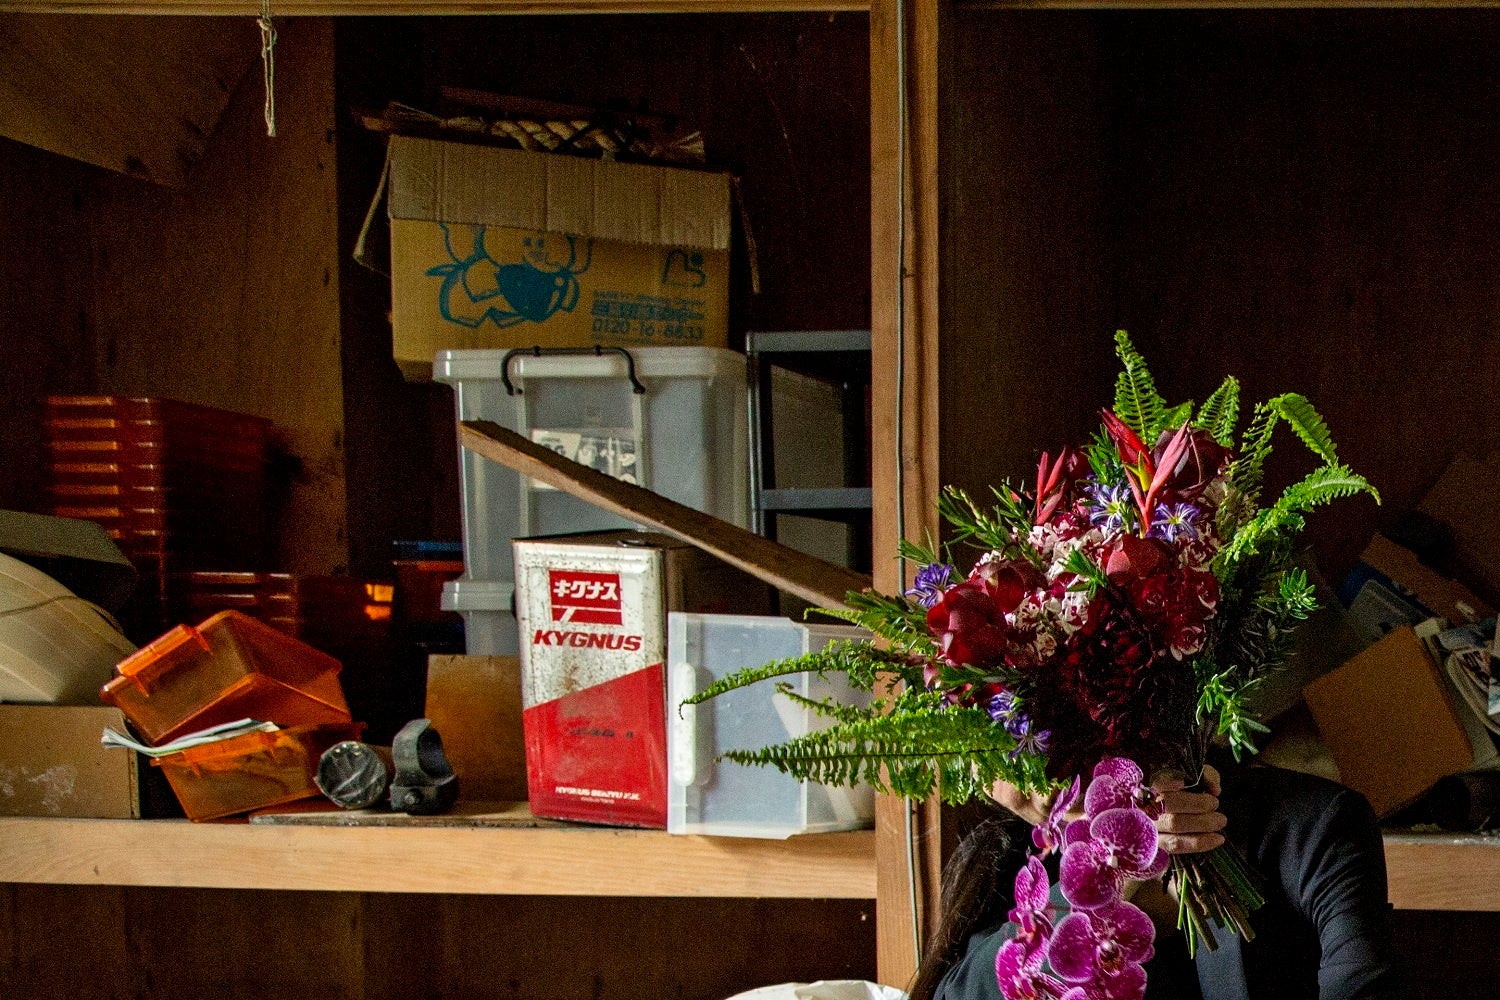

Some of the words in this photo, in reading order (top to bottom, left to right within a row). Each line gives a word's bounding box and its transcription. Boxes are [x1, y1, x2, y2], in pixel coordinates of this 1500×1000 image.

[552, 579, 618, 601] キグナス
[534, 629, 642, 652] KYGNUS
